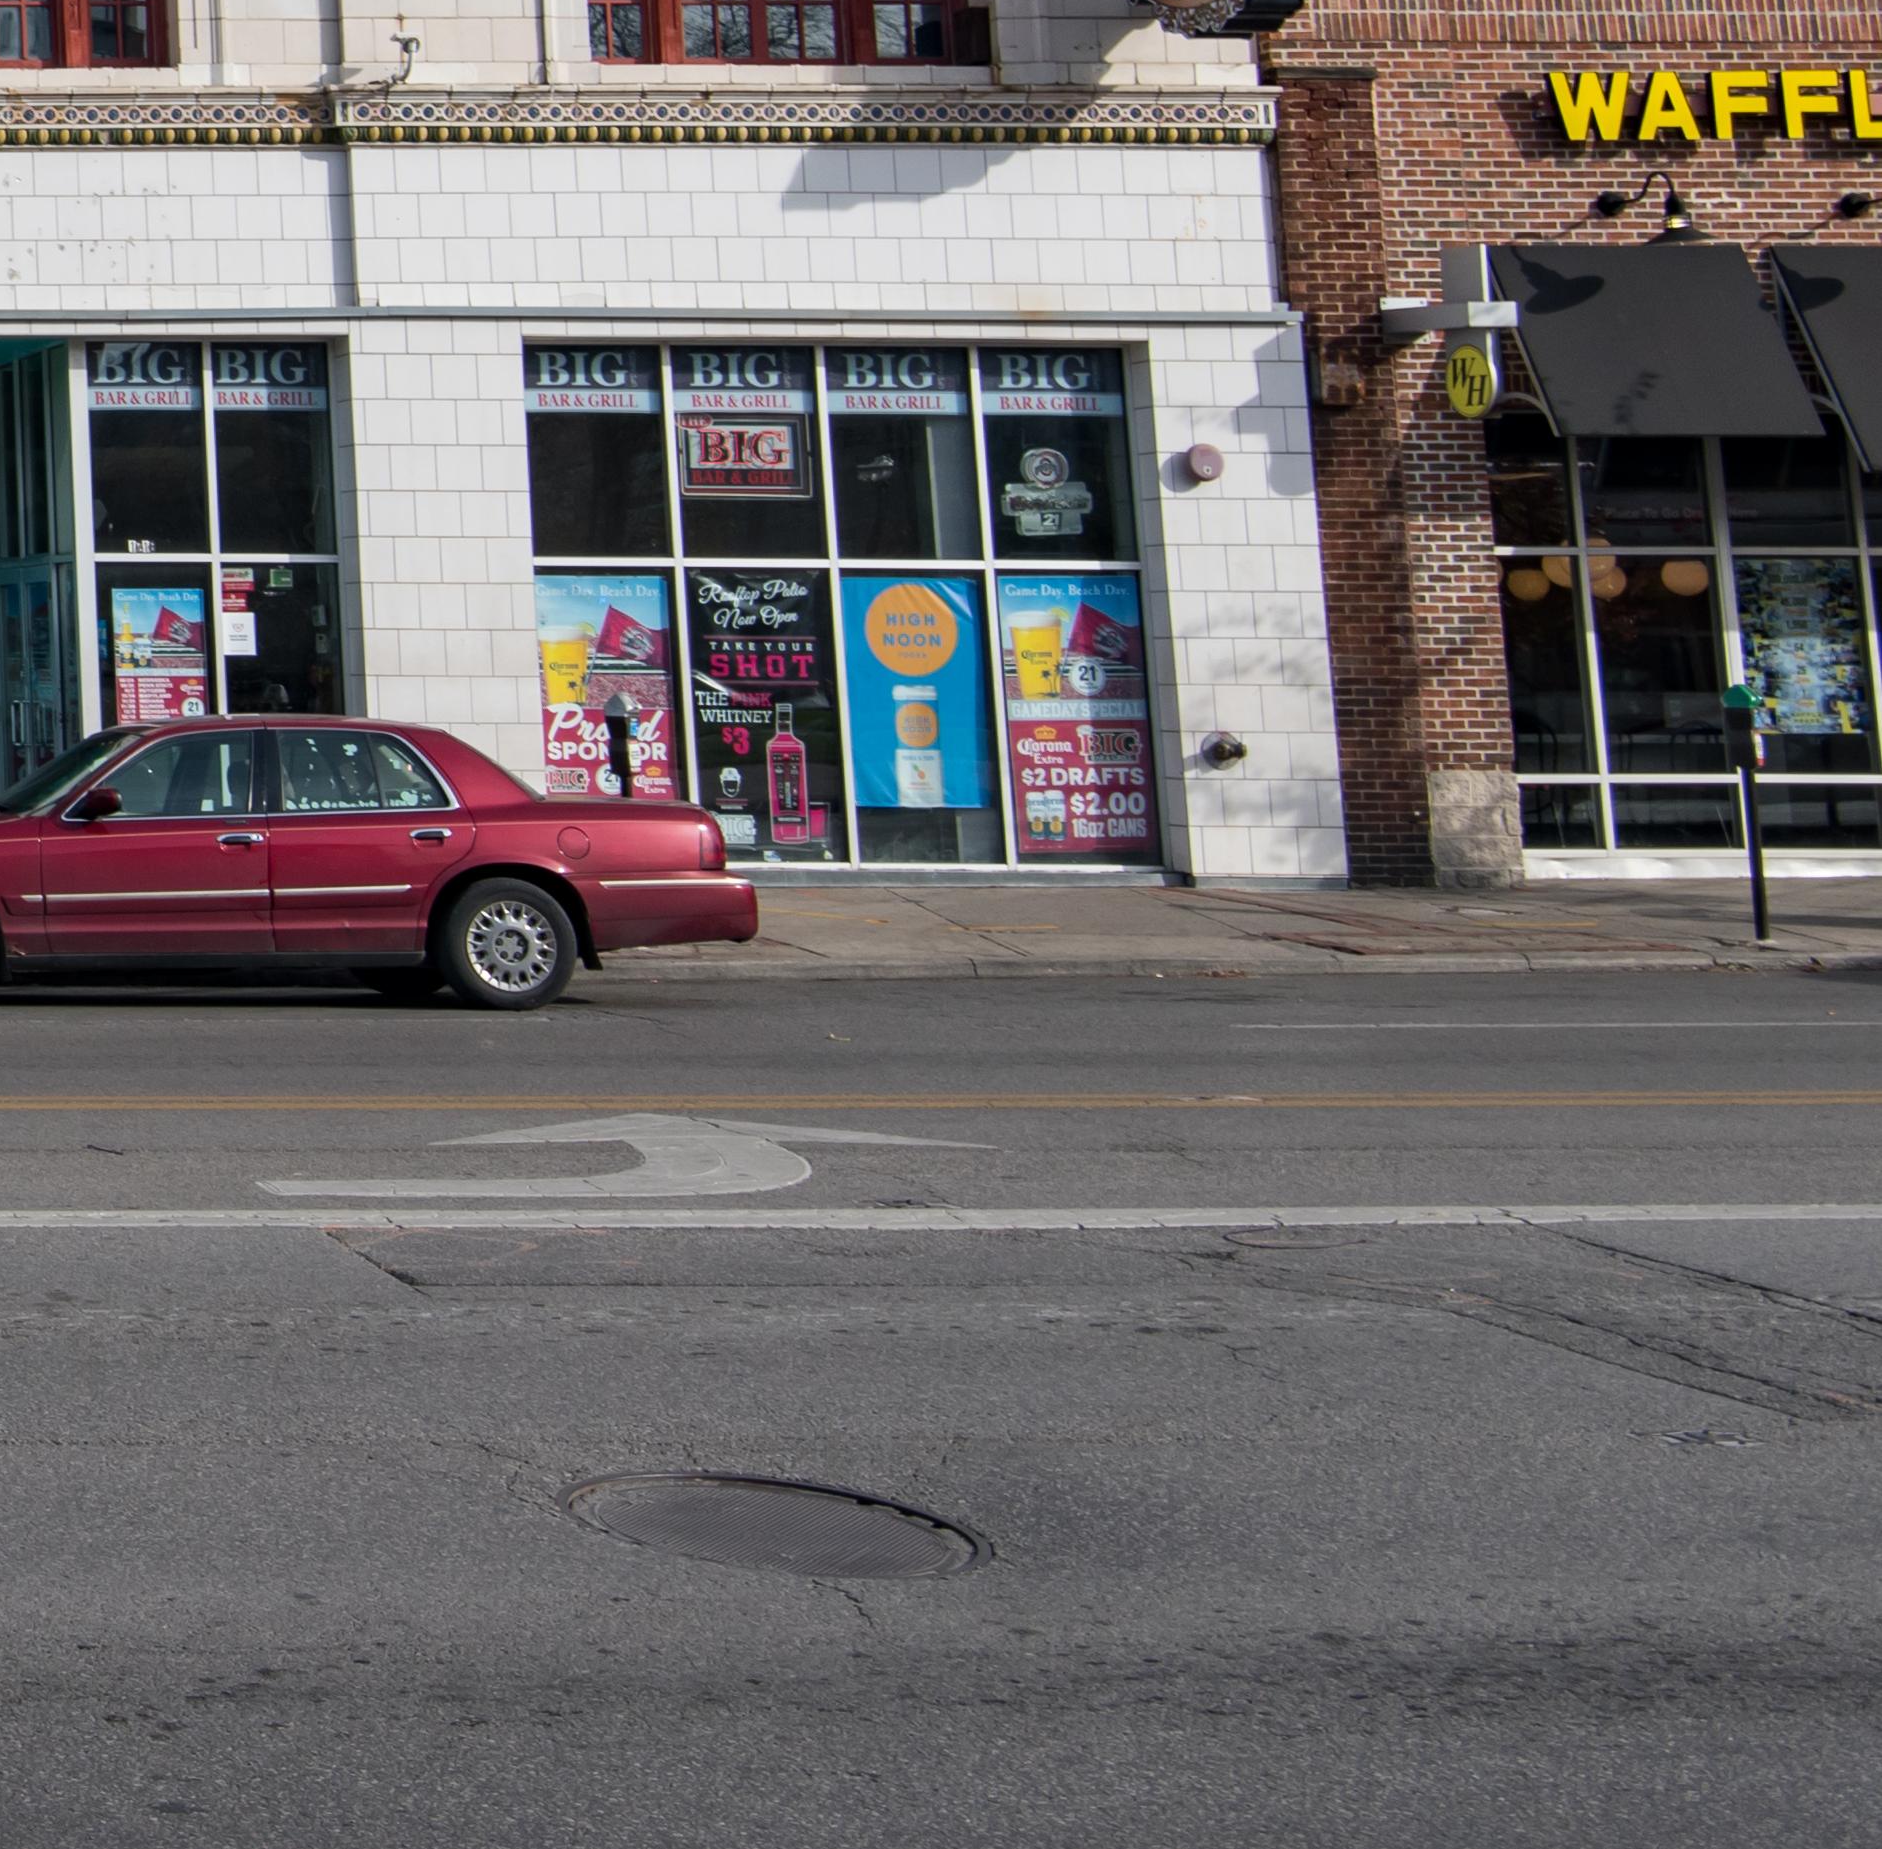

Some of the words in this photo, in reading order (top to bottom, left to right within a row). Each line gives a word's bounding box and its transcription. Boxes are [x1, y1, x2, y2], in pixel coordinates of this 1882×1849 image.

[93, 349, 186, 384] BIG
[216, 349, 308, 384] BIG
[536, 352, 628, 386] BIG
[689, 353, 782, 388] BIG
[843, 353, 936, 389] BIG
[998, 354, 1091, 389] BIG
[94, 391, 126, 406] BAR
[130, 391, 142, 406] &
[144, 391, 192, 406] GRILL
[217, 391, 249, 406] BAR
[253, 391, 264, 406] &
[267, 391, 314, 406] GRILL
[538, 393, 570, 408] BAR
[573, 393, 585, 408] &
[588, 393, 638, 408] GRILL
[691, 394, 724, 408] BAR
[727, 394, 740, 408] &
[741, 394, 791, 408] GRILL
[845, 394, 877, 410] BAR
[881, 394, 893, 410] &
[895, 394, 945, 410] GRILL
[1000, 396, 1032, 411] BAR
[1036, 396, 1048, 411] &
[1051, 396, 1101, 411] GRILL
[699, 428, 791, 467] BIG
[691, 470, 724, 485] BAR
[730, 470, 744, 485] &
[747, 470, 796, 485] GRILL
[599, 583, 633, 597] Beach
[698, 582, 760, 608] Rooftop
[762, 579, 809, 601] Patio
[1004, 583, 1039, 597] Game
[1040, 583, 1065, 599] Day.
[1067, 583, 1101, 596] Beach
[713, 608, 757, 629] Now
[760, 605, 799, 629] Open
[885, 612, 936, 626] HIGH
[709, 641, 756, 651] TAKE
[763, 641, 813, 652] YOUR
[882, 633, 942, 647] NOON
[709, 653, 814, 679] SHOT
[1078, 665, 1097, 682] 21
[187, 701, 200, 712] 21
[695, 690, 729, 706] THE
[700, 709, 773, 724] WHITNEY
[1012, 701, 1077, 718] GAMEDAY
[1080, 701, 1143, 718] SPECIAL
[547, 702, 664, 742] Prod
[721, 726, 751, 755] $3
[1016, 737, 1074, 757] Corona
[1078, 731, 1143, 757] BIG
[547, 740, 668, 761] SPONOR
[1033, 754, 1065, 765] Extra
[547, 769, 590, 787] BIG
[1020, 767, 1047, 787] $2
[1050, 767, 1146, 786] DRAFTS
[1069, 791, 1147, 816] $2.00
[1071, 817, 1106, 839] 16oz
[1107, 817, 1148, 839] CANS
